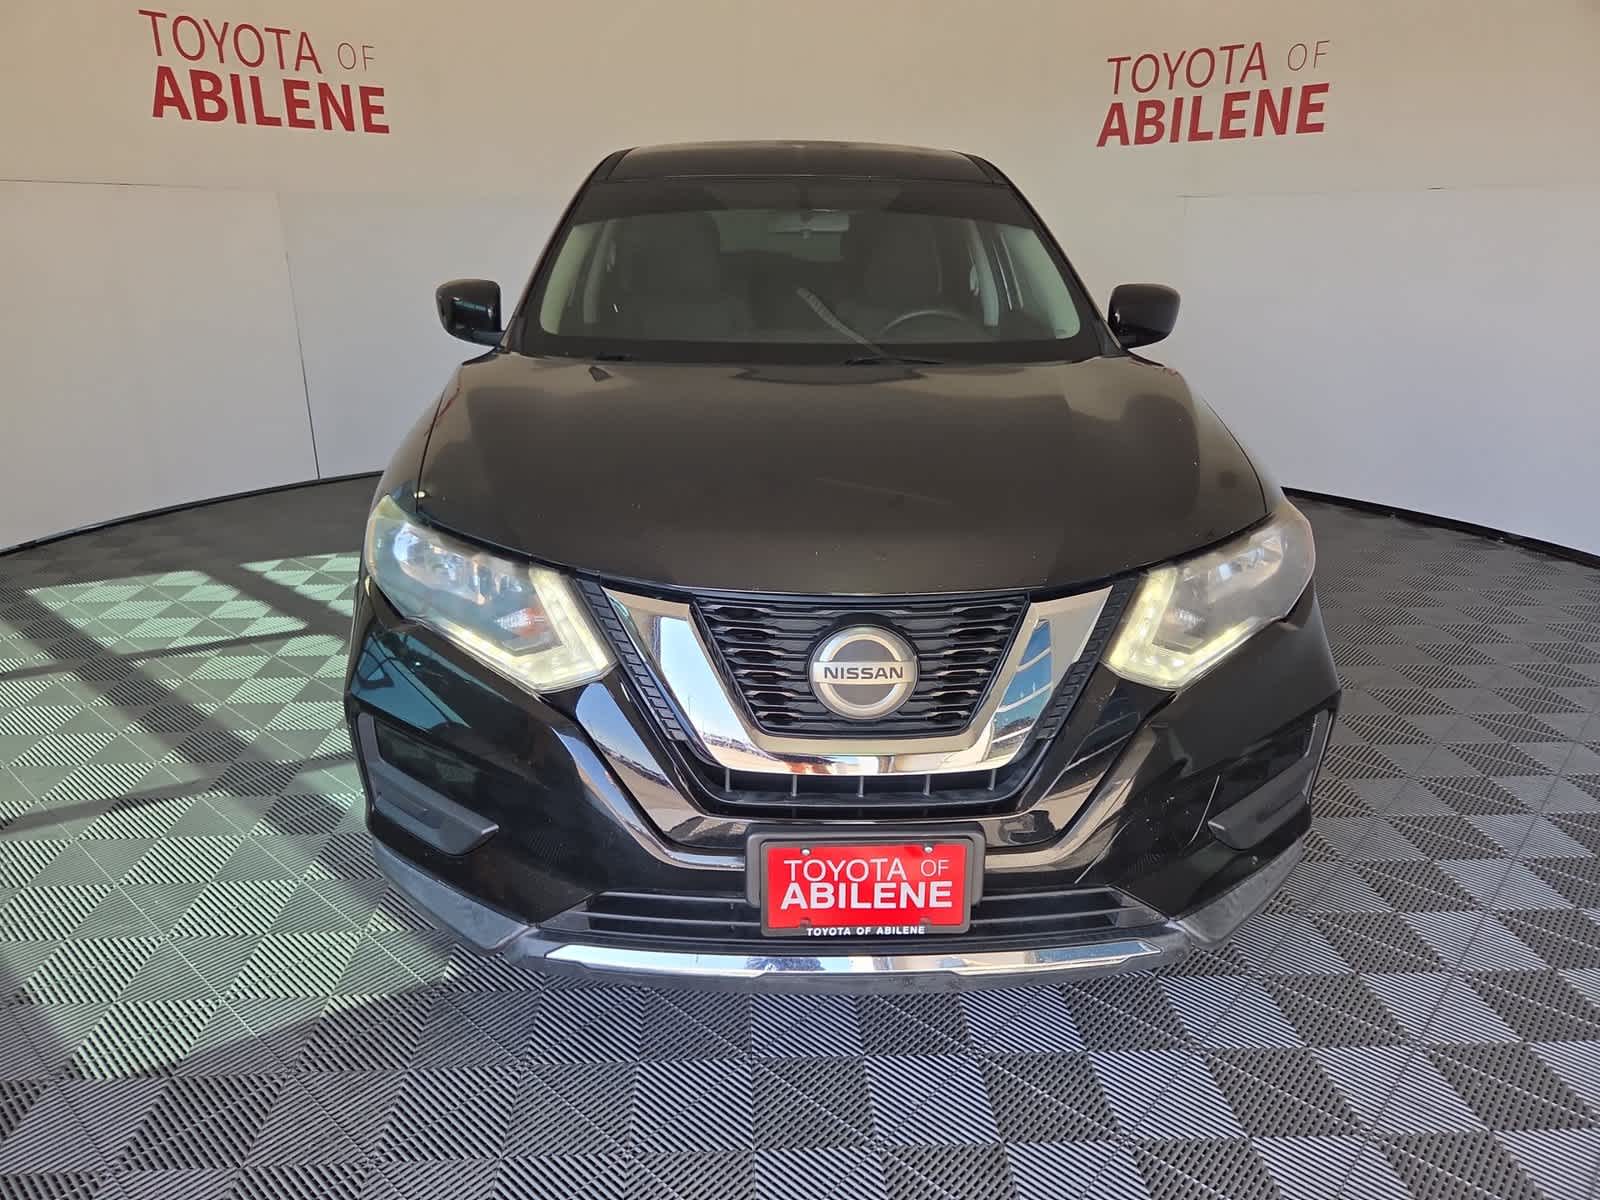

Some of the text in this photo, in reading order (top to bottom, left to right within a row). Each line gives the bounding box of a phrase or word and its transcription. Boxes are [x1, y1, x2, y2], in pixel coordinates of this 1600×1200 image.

[138, 9, 375, 74] TOYOTA OF
[1107, 40, 1330, 95] TOYOTA OF
[152, 65, 390, 134] ABILENE
[1096, 83, 1330, 147] ABILENE
[823, 666, 904, 680] NISSAN
[784, 858, 949, 882] TOYOTA OF
[780, 880, 953, 910] ABILENE
[806, 926, 925, 937] TOYOTA OF ABILENE
